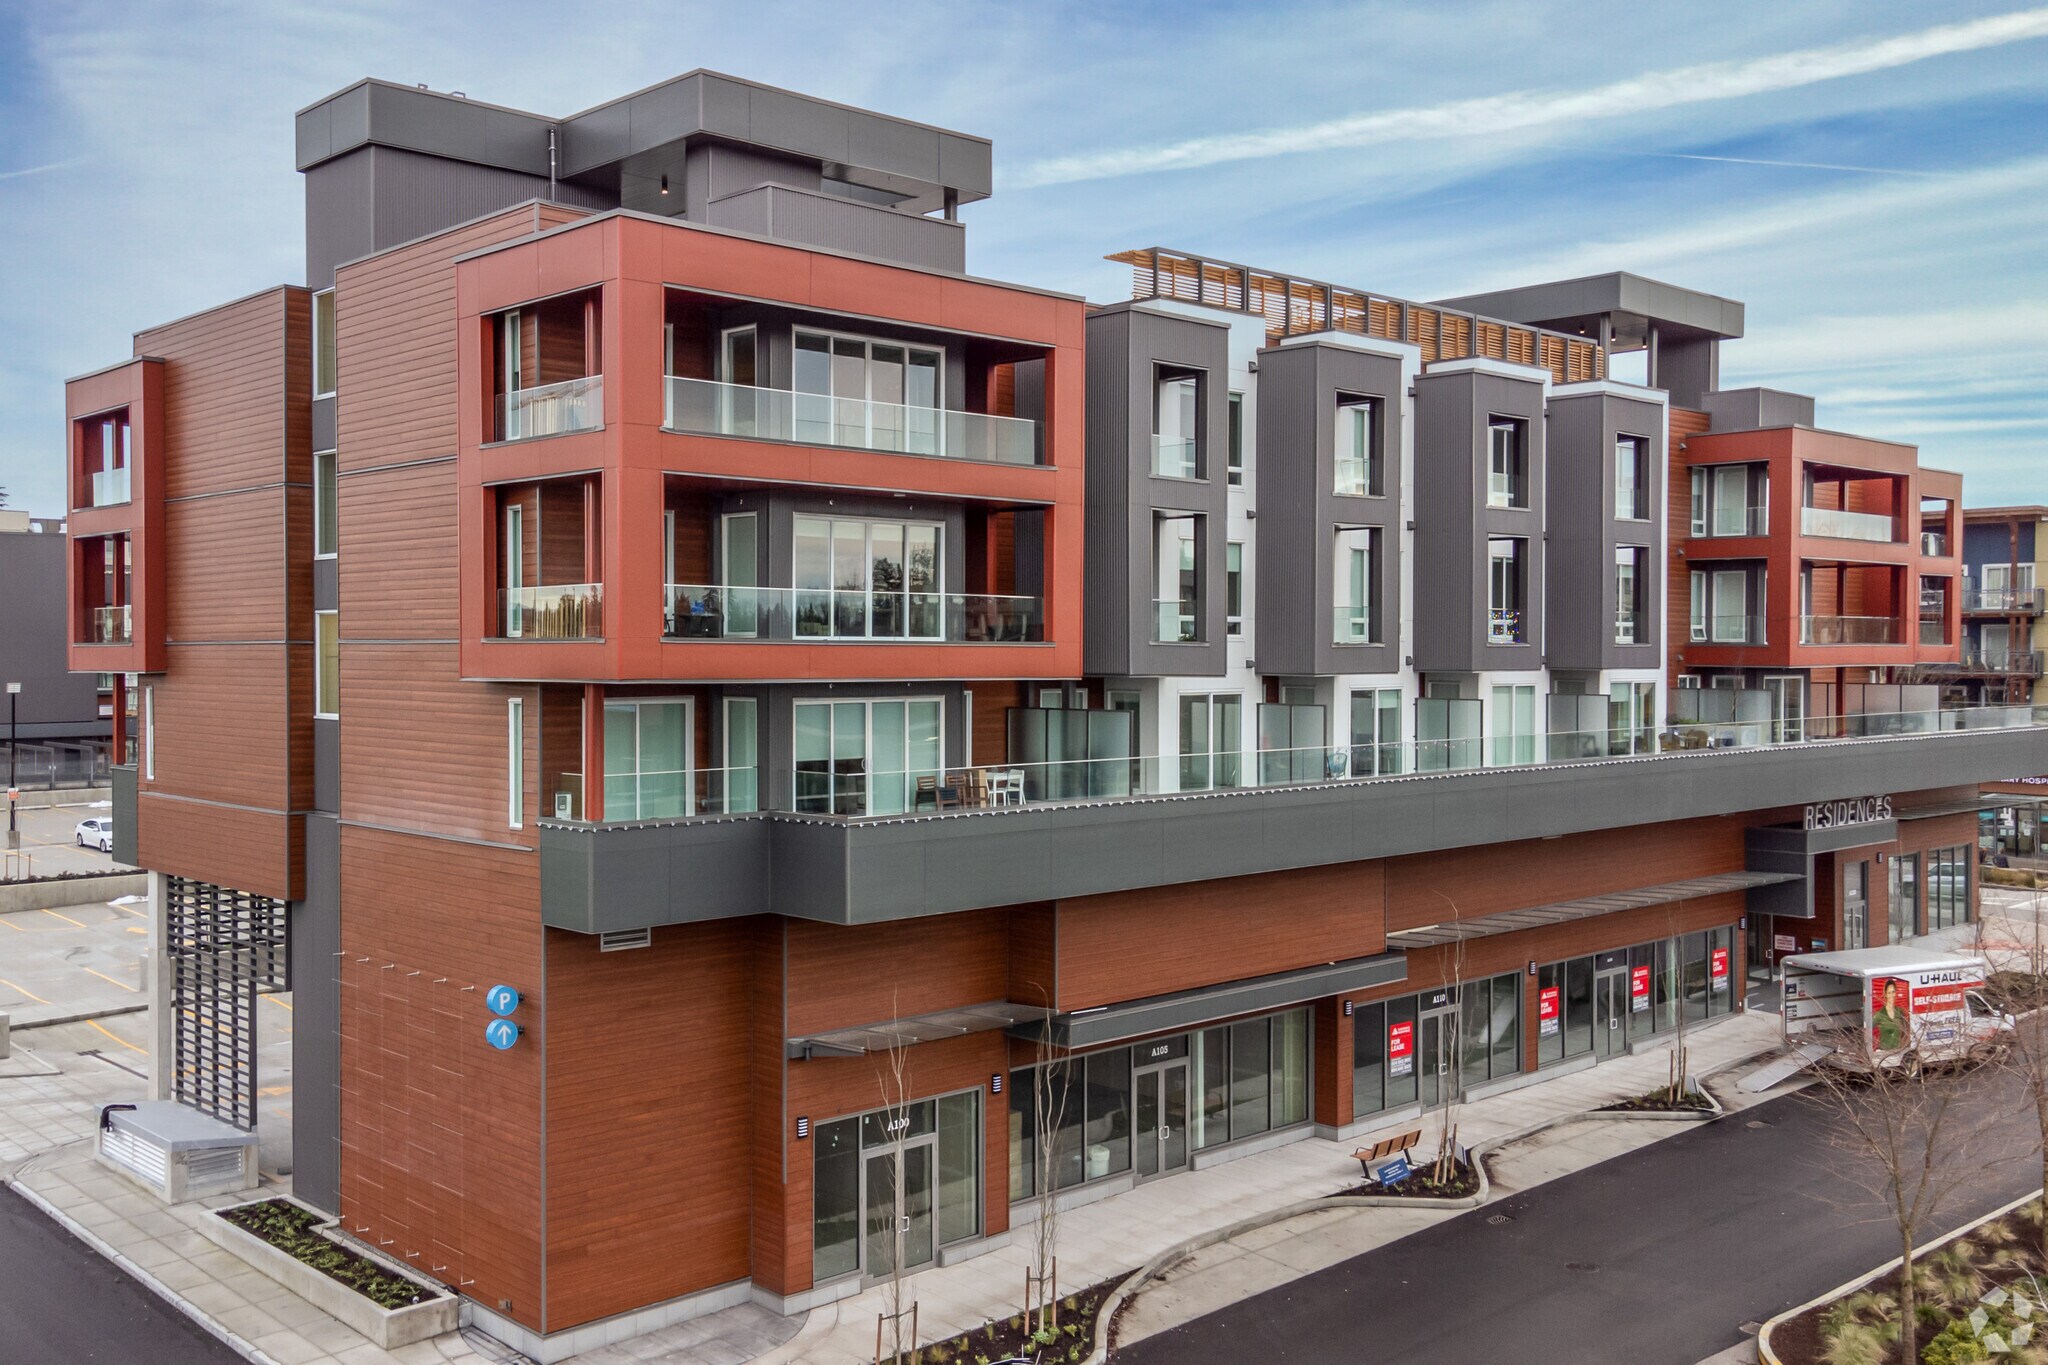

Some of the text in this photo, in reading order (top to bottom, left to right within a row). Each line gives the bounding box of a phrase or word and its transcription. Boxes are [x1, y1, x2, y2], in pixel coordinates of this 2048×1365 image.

[1804, 796, 1892, 830] RESIDENCES
[500, 992, 511, 1010] P
[1541, 1006, 1553, 1015] LEASE
[1391, 1038, 1401, 1047] FOR
[1391, 1043, 1405, 1052] LEASE
[1151, 1045, 1168, 1056] A105
[887, 1117, 910, 1131] A100
